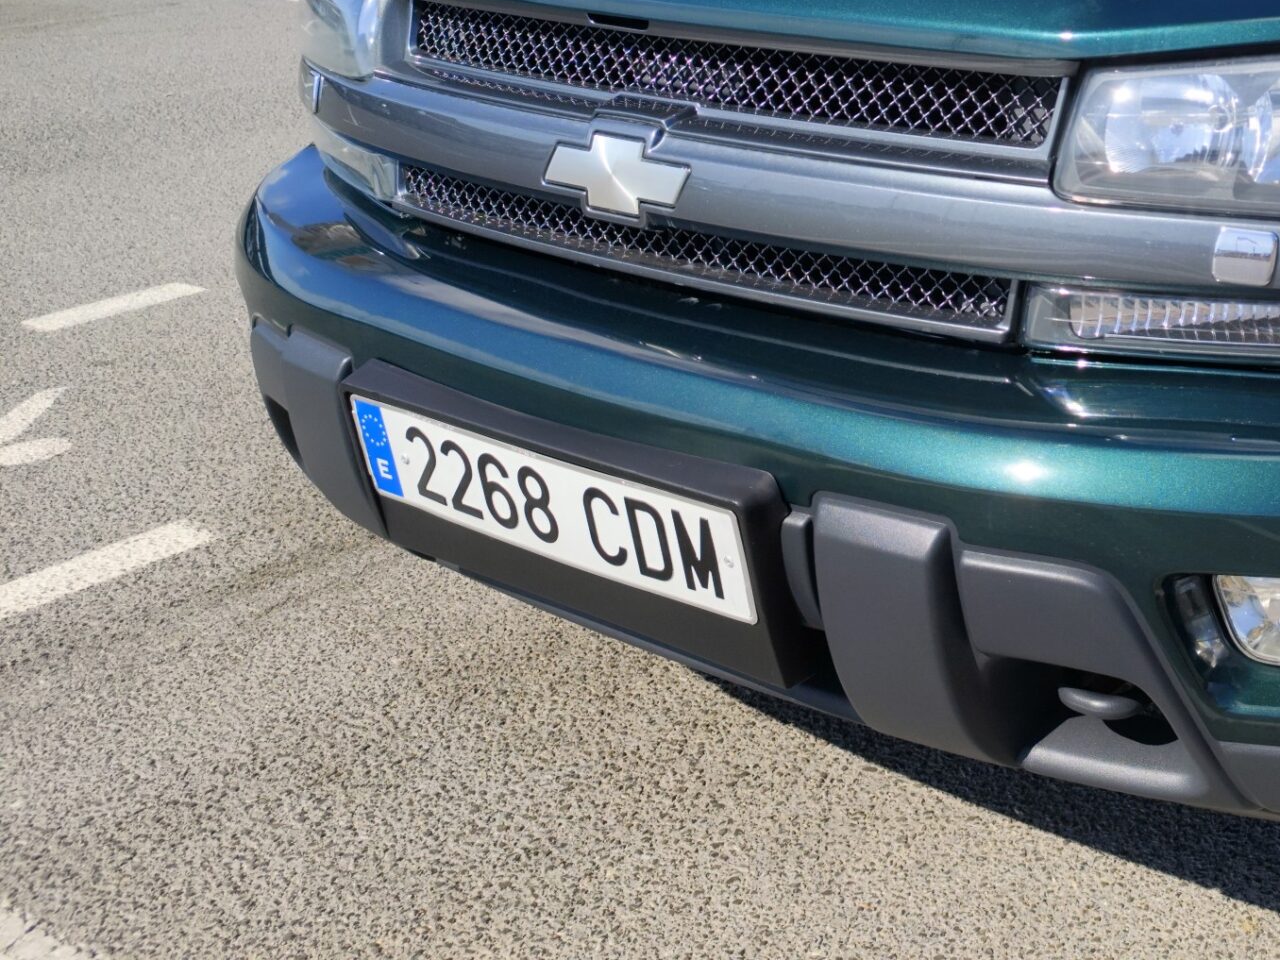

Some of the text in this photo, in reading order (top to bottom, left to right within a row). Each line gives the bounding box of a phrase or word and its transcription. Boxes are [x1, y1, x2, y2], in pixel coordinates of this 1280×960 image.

[376, 457, 393, 480] E
[405, 426, 725, 600] 2268 CDM
